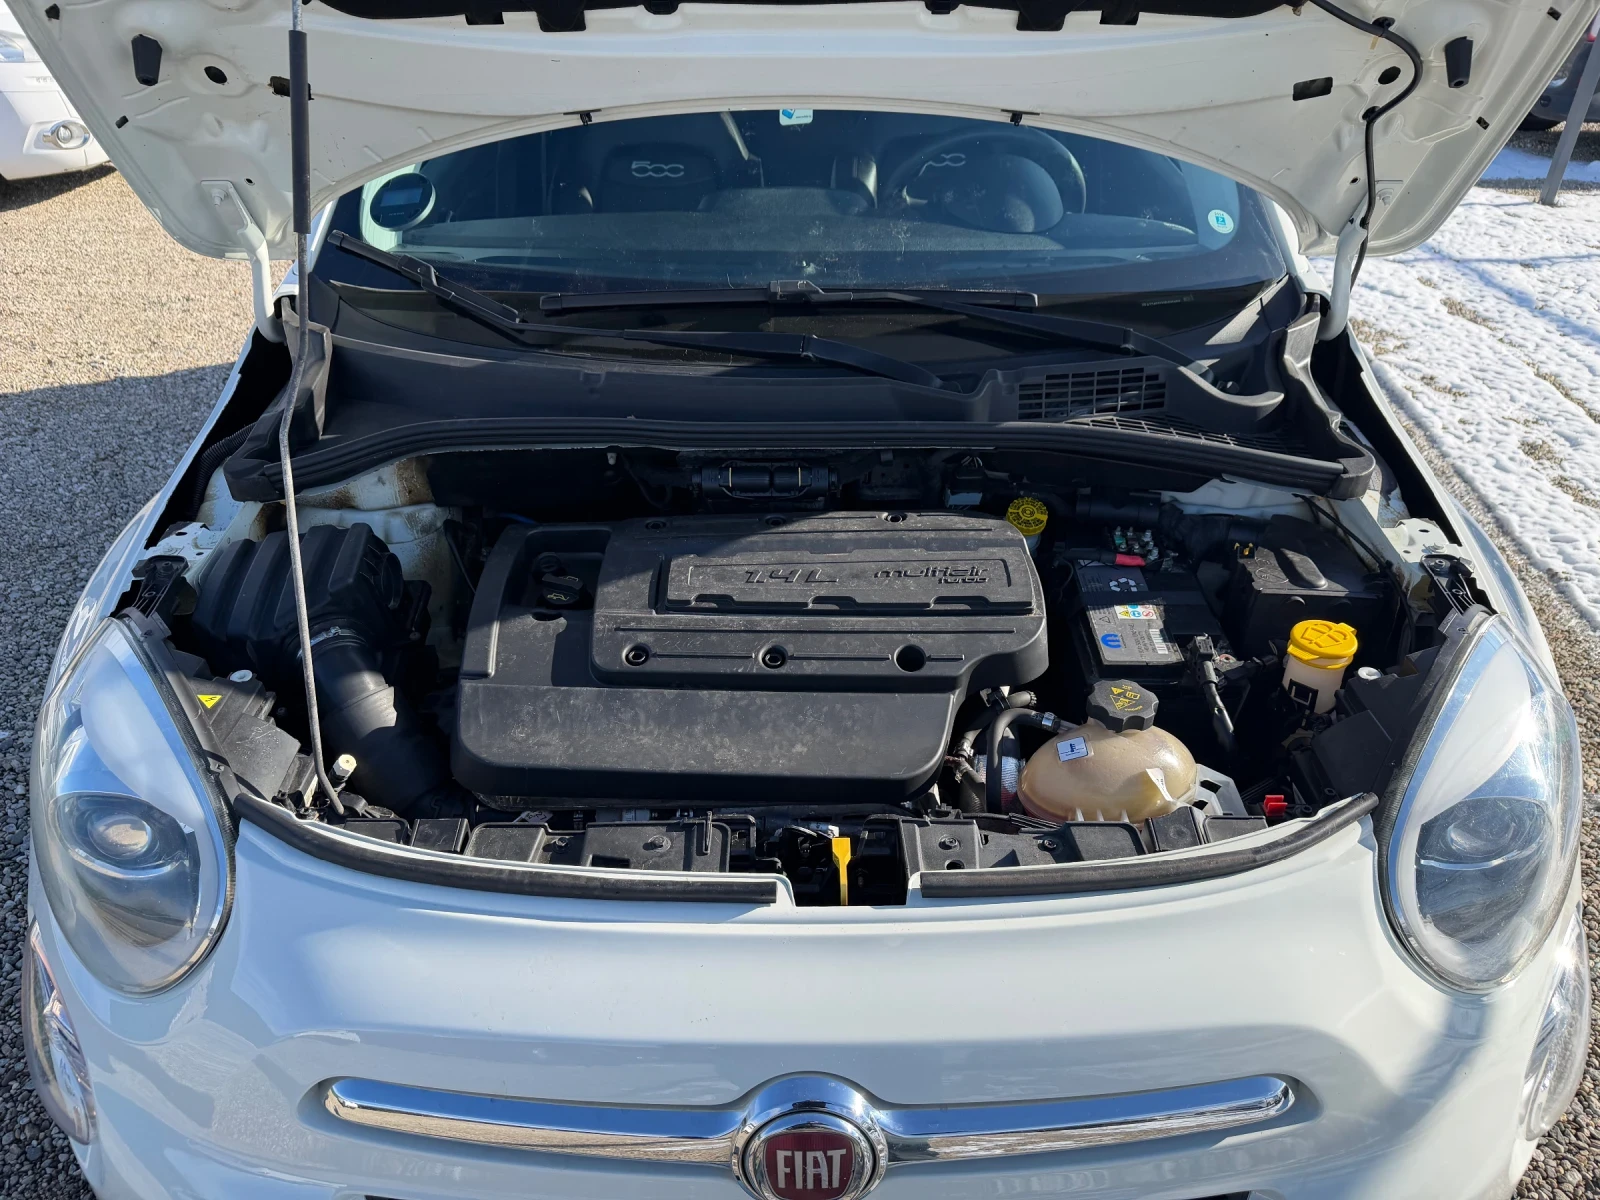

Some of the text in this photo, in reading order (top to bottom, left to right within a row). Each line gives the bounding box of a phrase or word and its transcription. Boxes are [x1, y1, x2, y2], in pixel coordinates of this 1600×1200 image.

[631, 160, 685, 178] 500
[873, 566, 989, 578] multiair
[937, 576, 990, 585] turbo
[776, 1148, 847, 1189] FIAT
